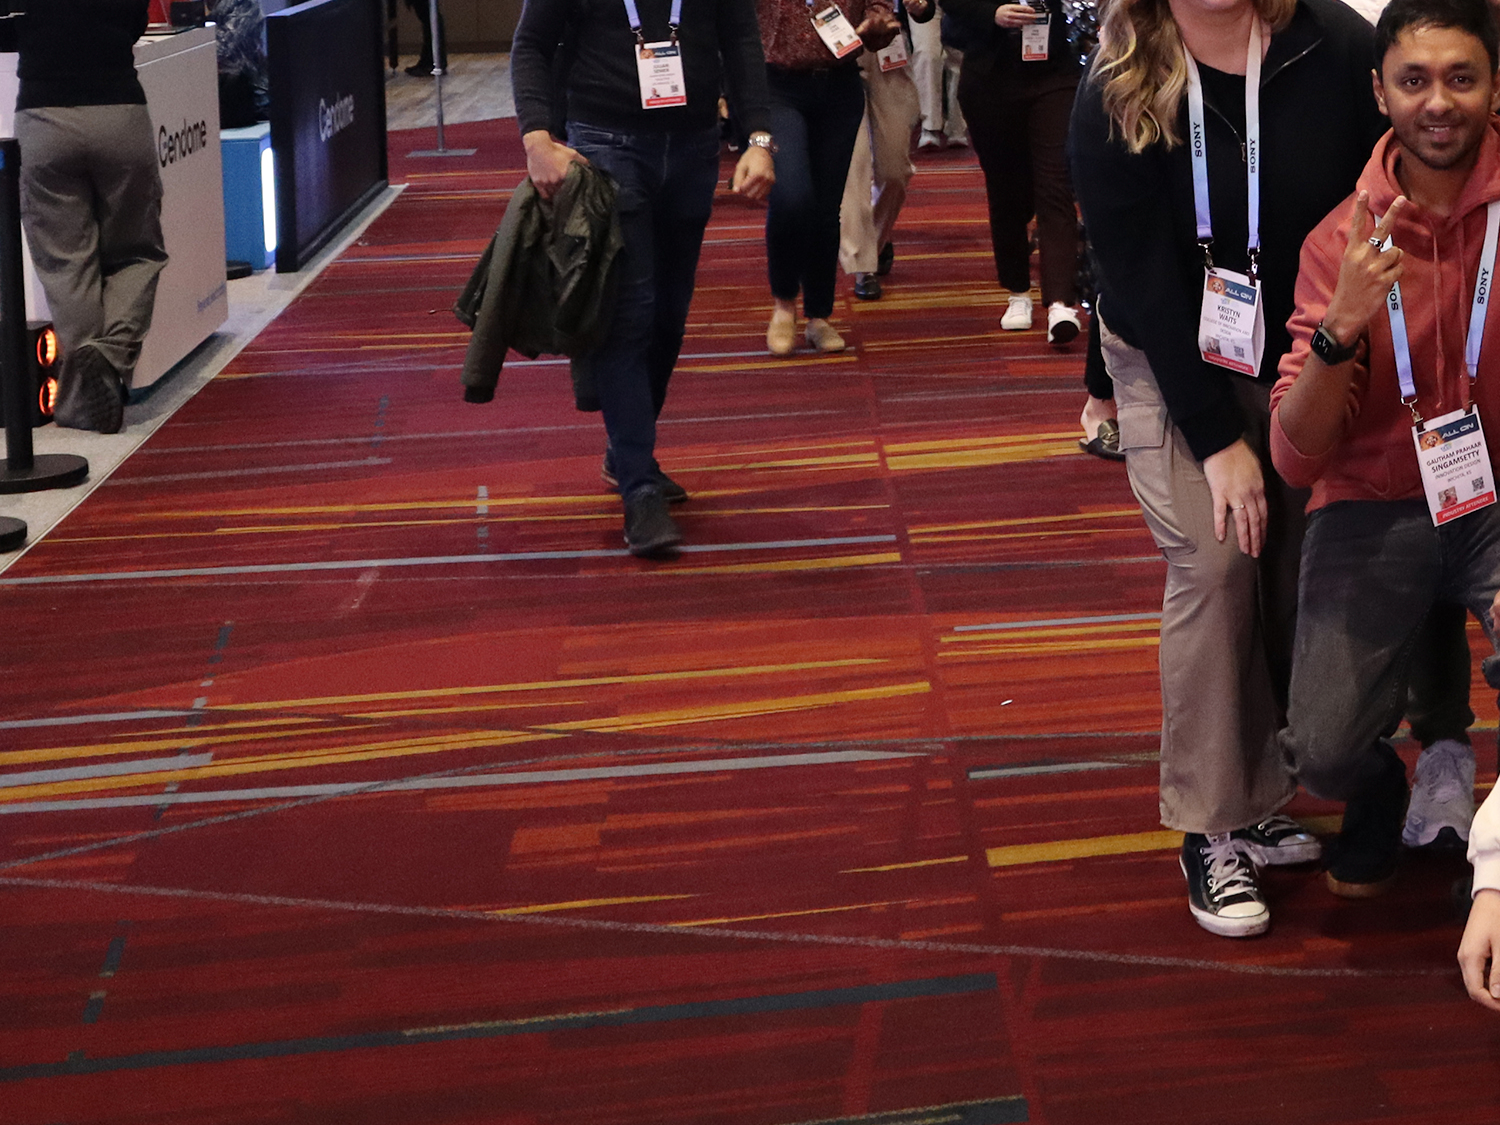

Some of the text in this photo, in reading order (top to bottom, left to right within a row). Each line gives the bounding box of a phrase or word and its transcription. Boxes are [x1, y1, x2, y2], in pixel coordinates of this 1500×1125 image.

[158, 118, 207, 168] Gendome
[1193, 121, 1203, 158] SONY
[1477, 267, 1489, 305] SONY
[1217, 304, 1241, 319] KRISTYN
[1441, 422, 1474, 439] ALL ON
[1426, 441, 1482, 467] GAUTHAM PRAHAAR
[1431, 449, 1481, 474] SINGAMSETTY
